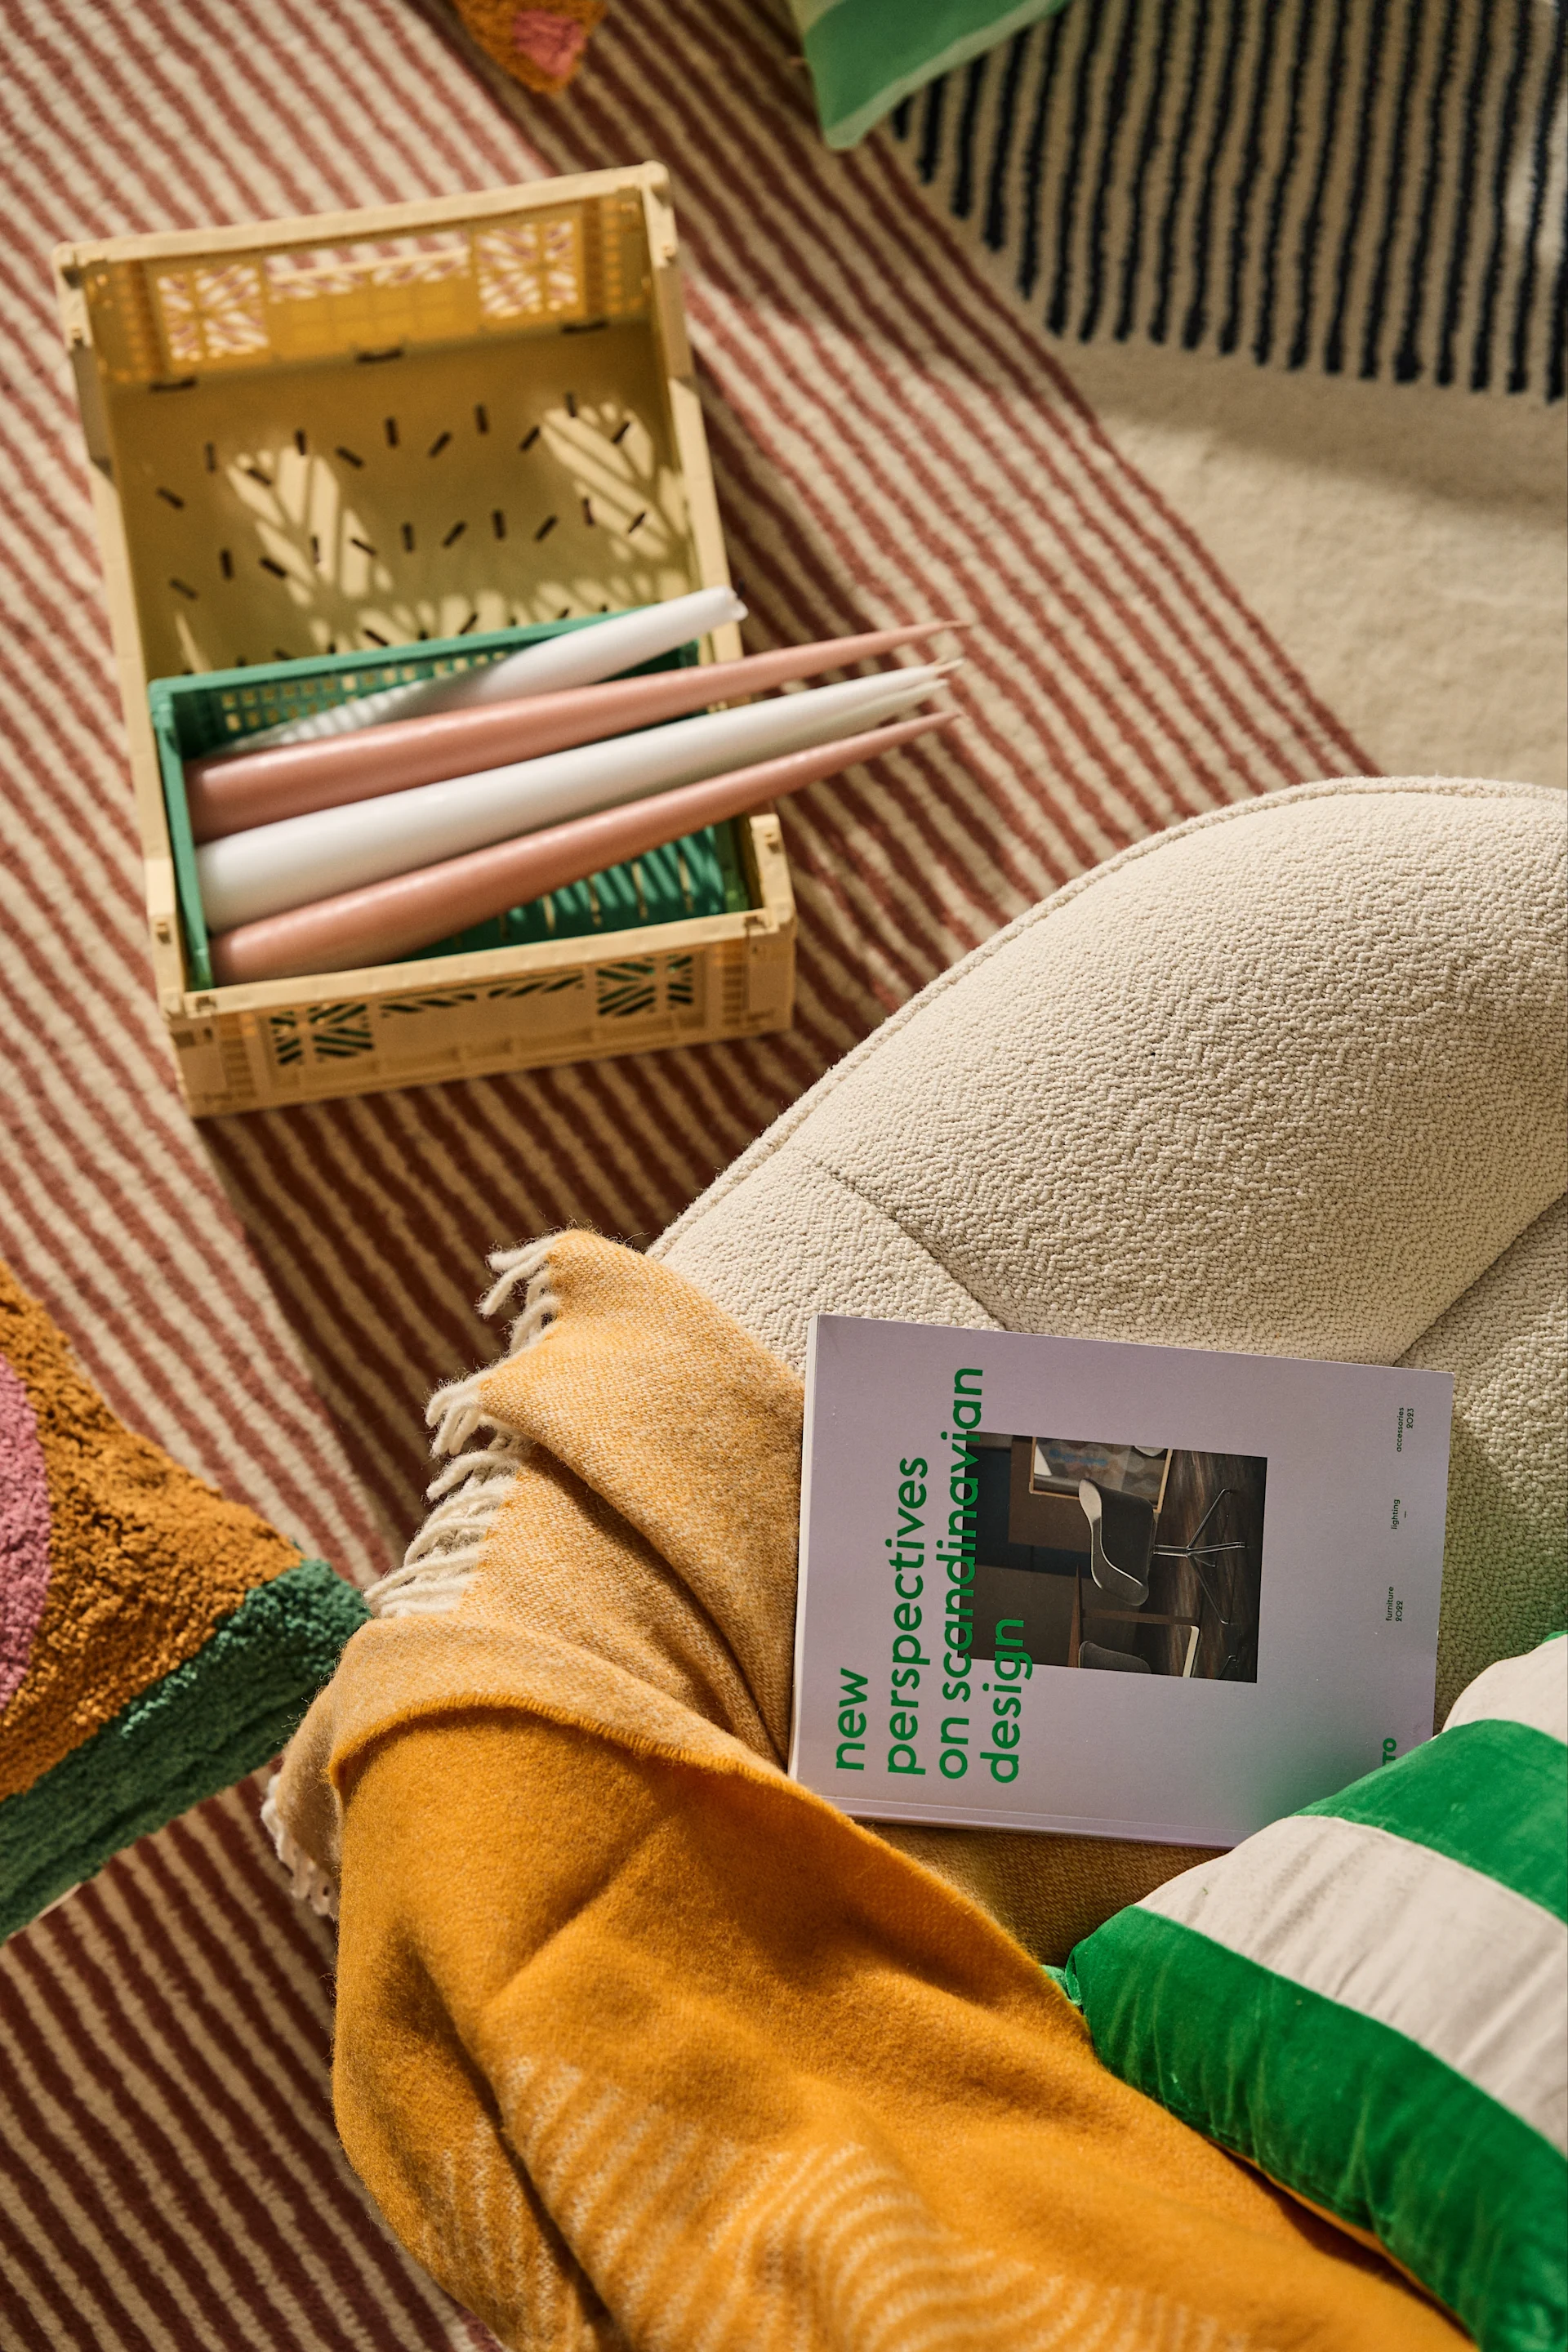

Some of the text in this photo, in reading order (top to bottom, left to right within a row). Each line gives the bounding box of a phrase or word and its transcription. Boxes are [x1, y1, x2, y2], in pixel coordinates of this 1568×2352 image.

[1396, 1406, 1405, 1452] accessories
[1405, 1407, 1414, 1429] 2023
[1391, 1499, 1401, 1530] lighting
[936, 1368, 982, 1780] on scandinavian
[885, 1458, 930, 1775] perspectives
[1385, 1586, 1394, 1621] furniture
[1395, 1600, 1404, 1622] 2022
[835, 1668, 868, 1771] new
[979, 1619, 1033, 1784] design
